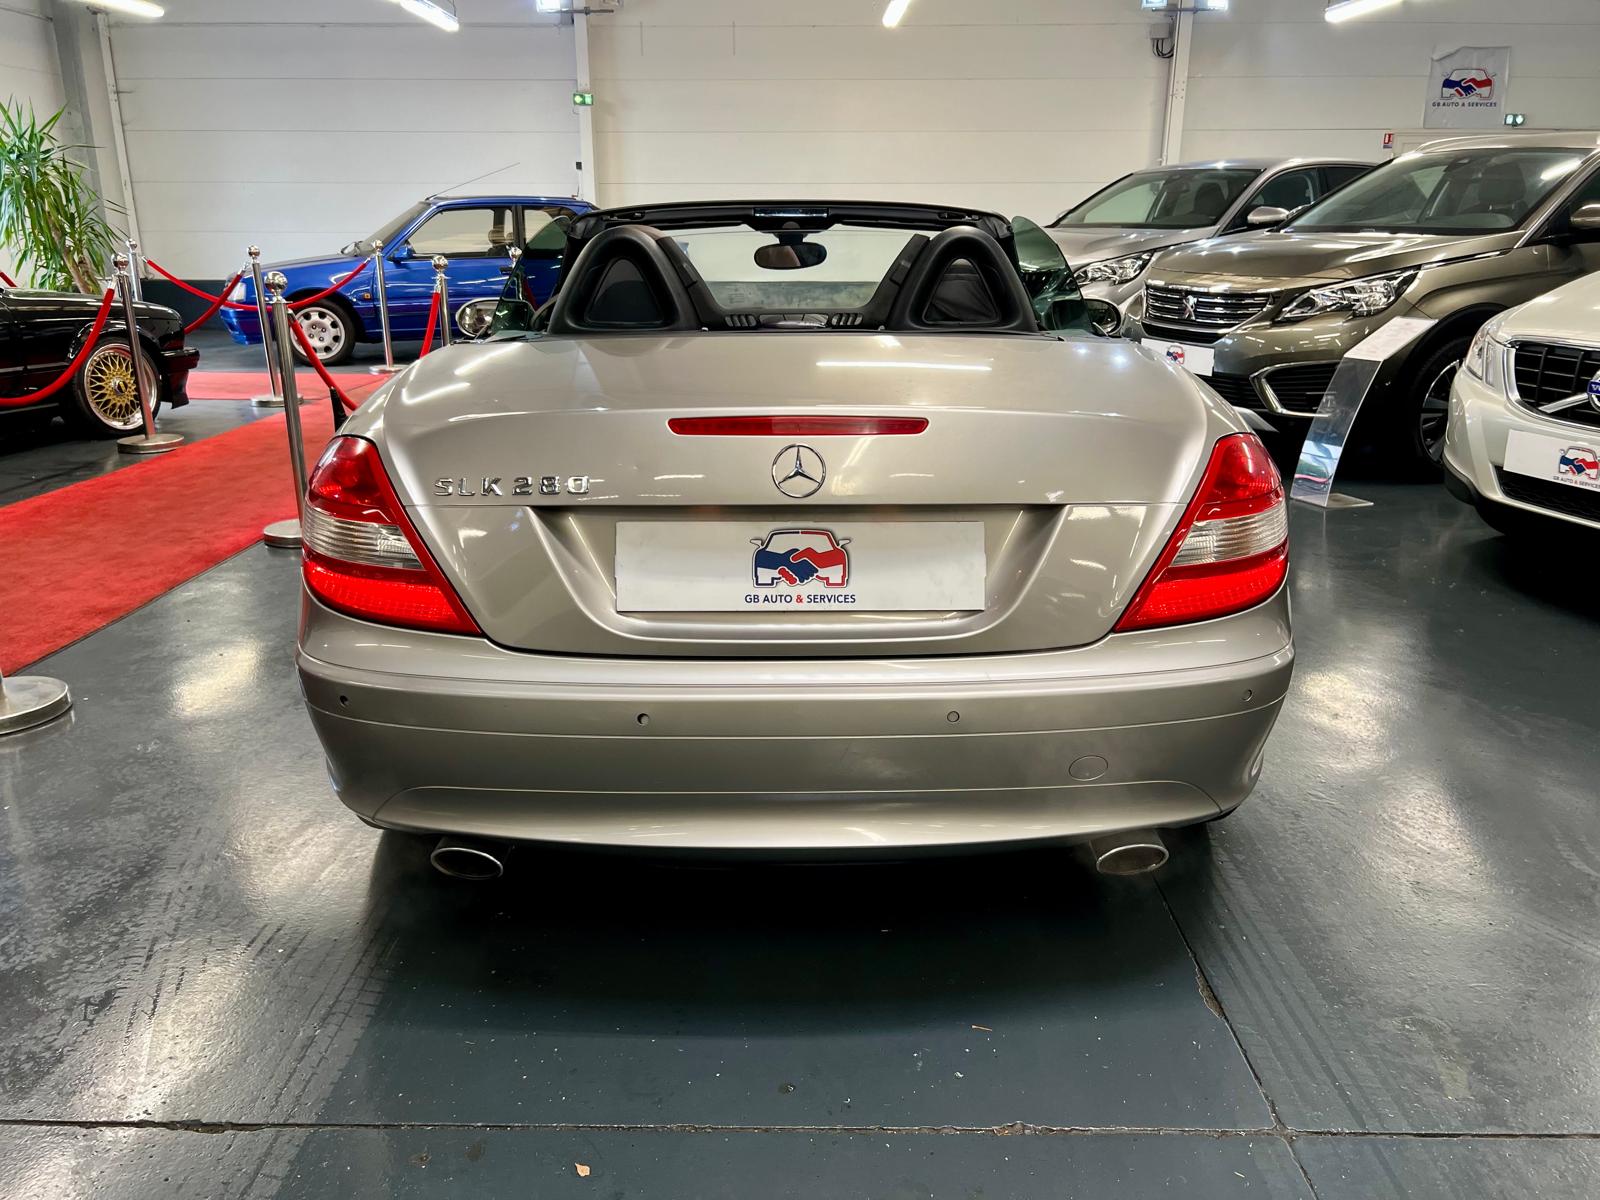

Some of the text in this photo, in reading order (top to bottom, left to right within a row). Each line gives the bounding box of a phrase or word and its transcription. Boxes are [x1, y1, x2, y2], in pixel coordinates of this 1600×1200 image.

[433, 476, 590, 496] SLK 280
[744, 594, 856, 604] GB AUTO & SERVICES
